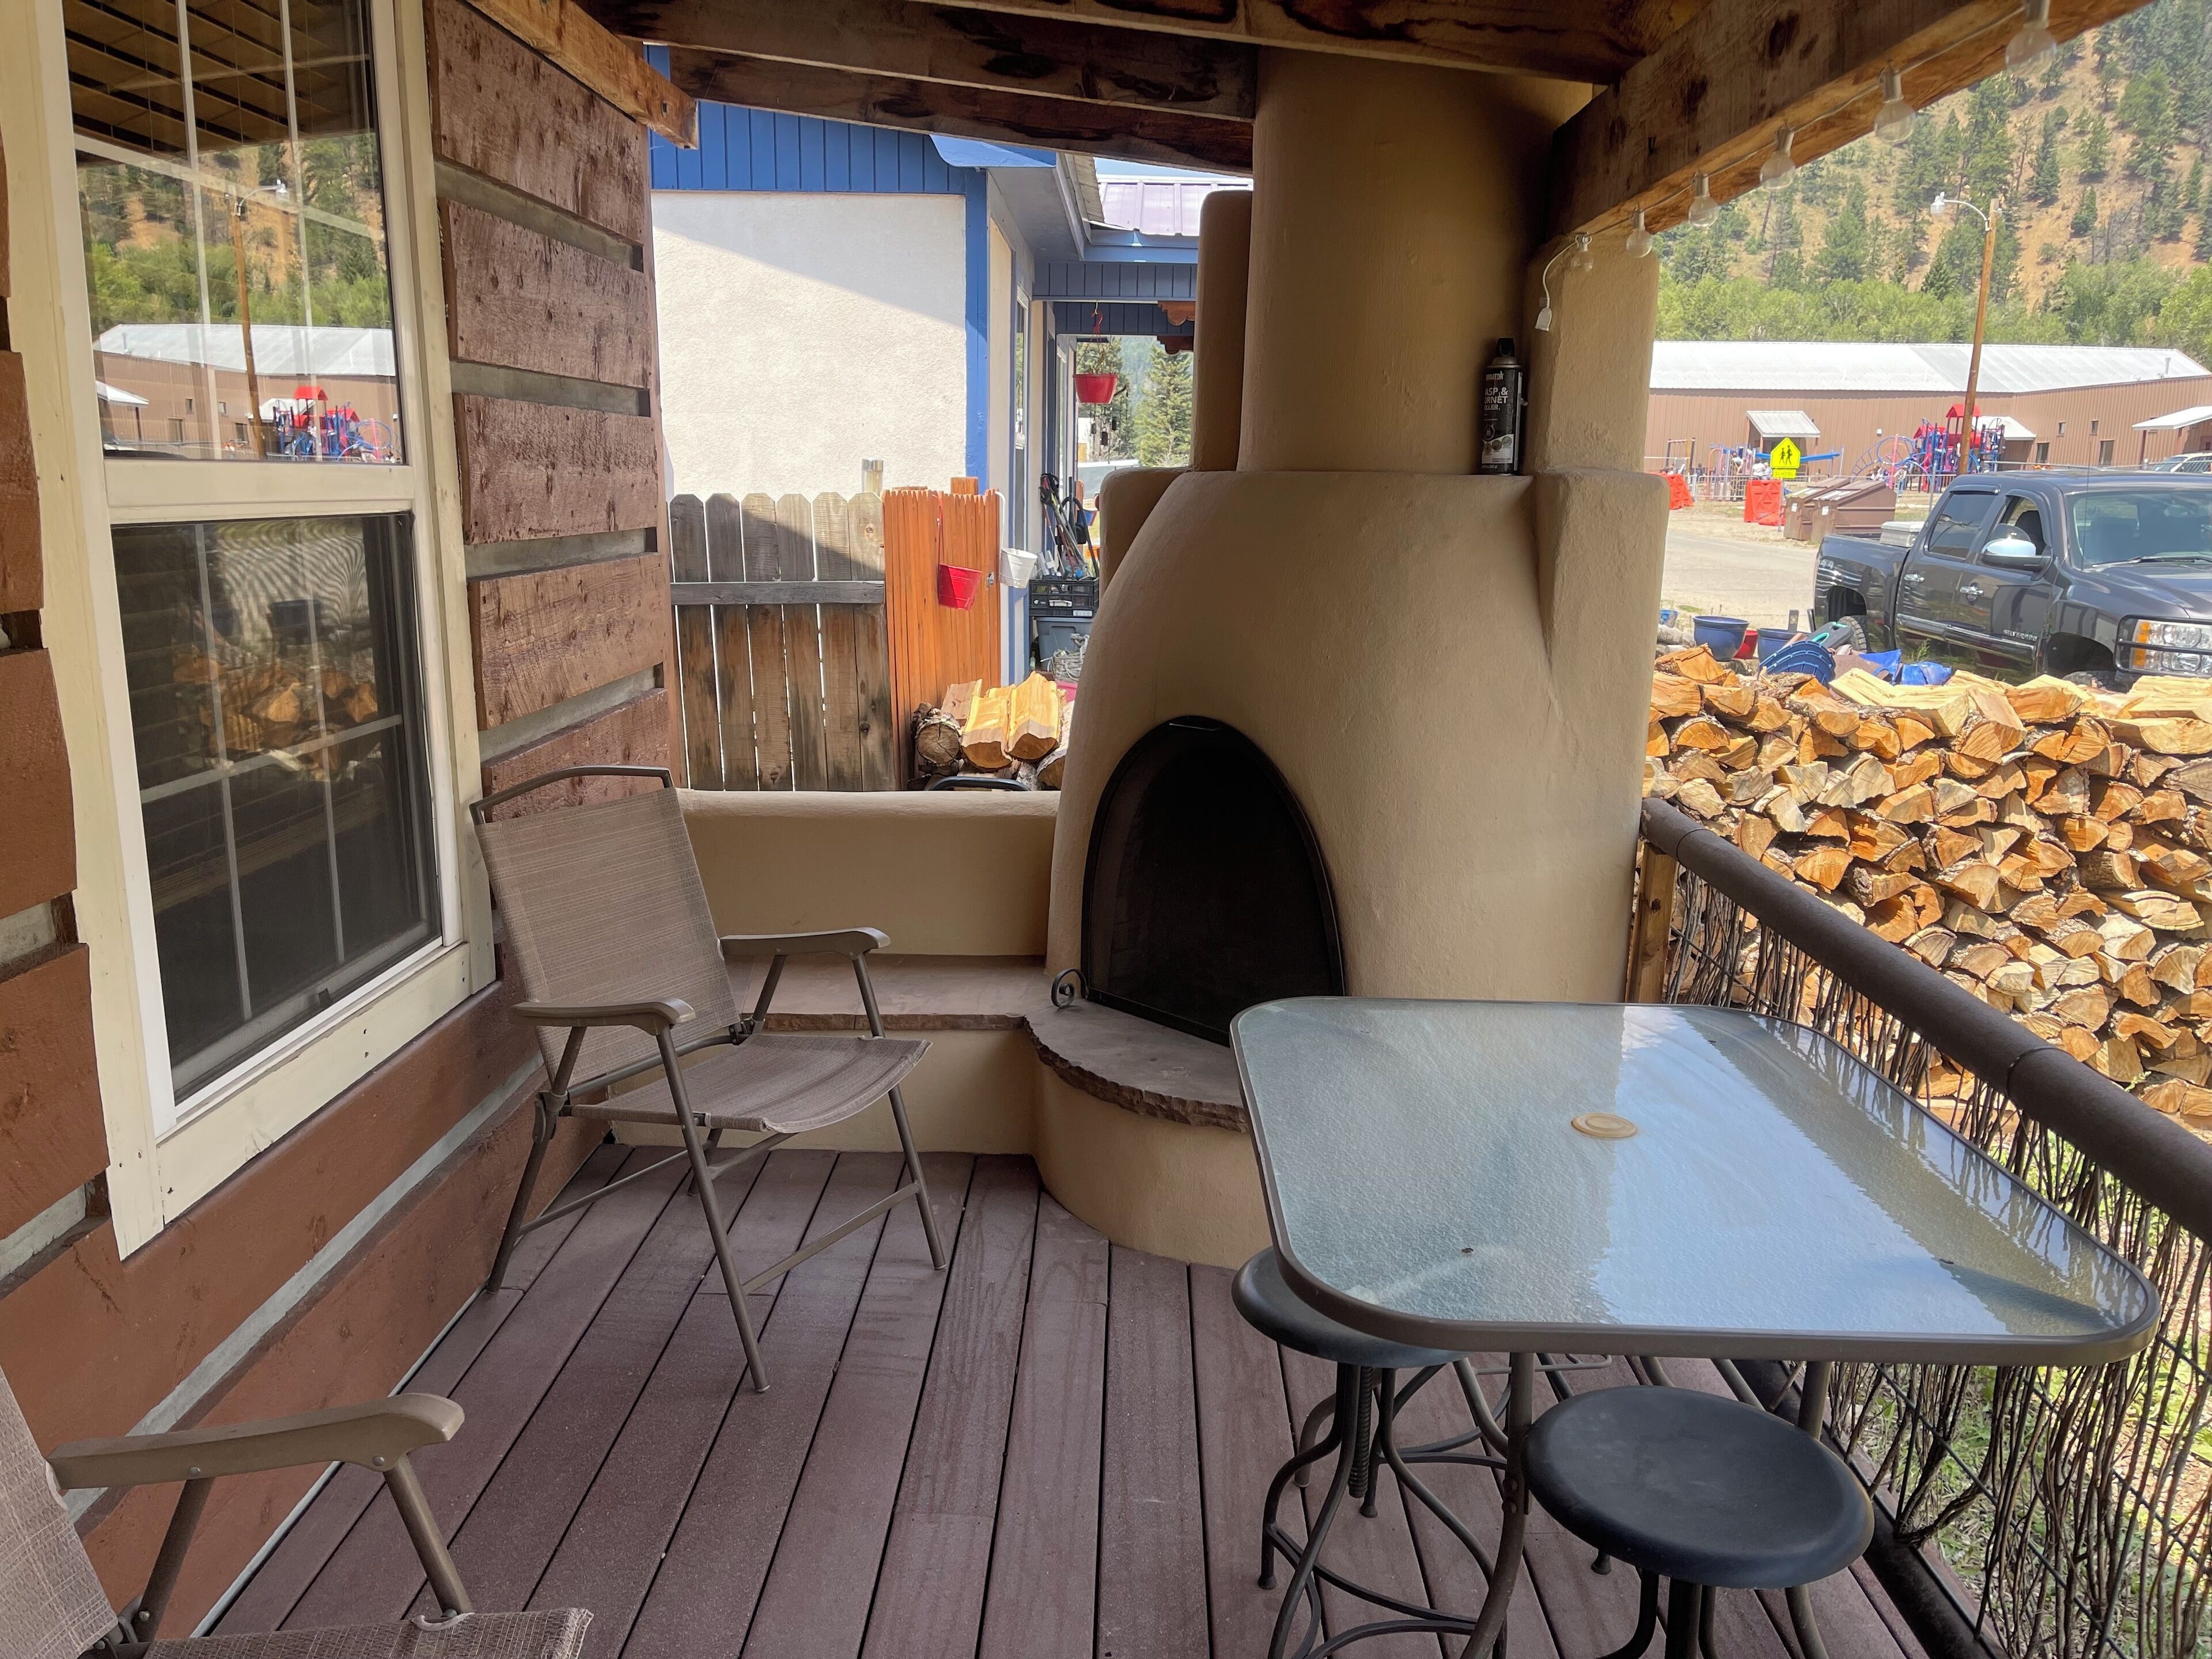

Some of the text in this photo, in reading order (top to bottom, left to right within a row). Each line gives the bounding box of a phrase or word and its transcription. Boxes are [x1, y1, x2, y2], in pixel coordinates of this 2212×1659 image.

[1484, 387, 1509, 396] ASP &
[1484, 396, 1508, 404] ORNET
